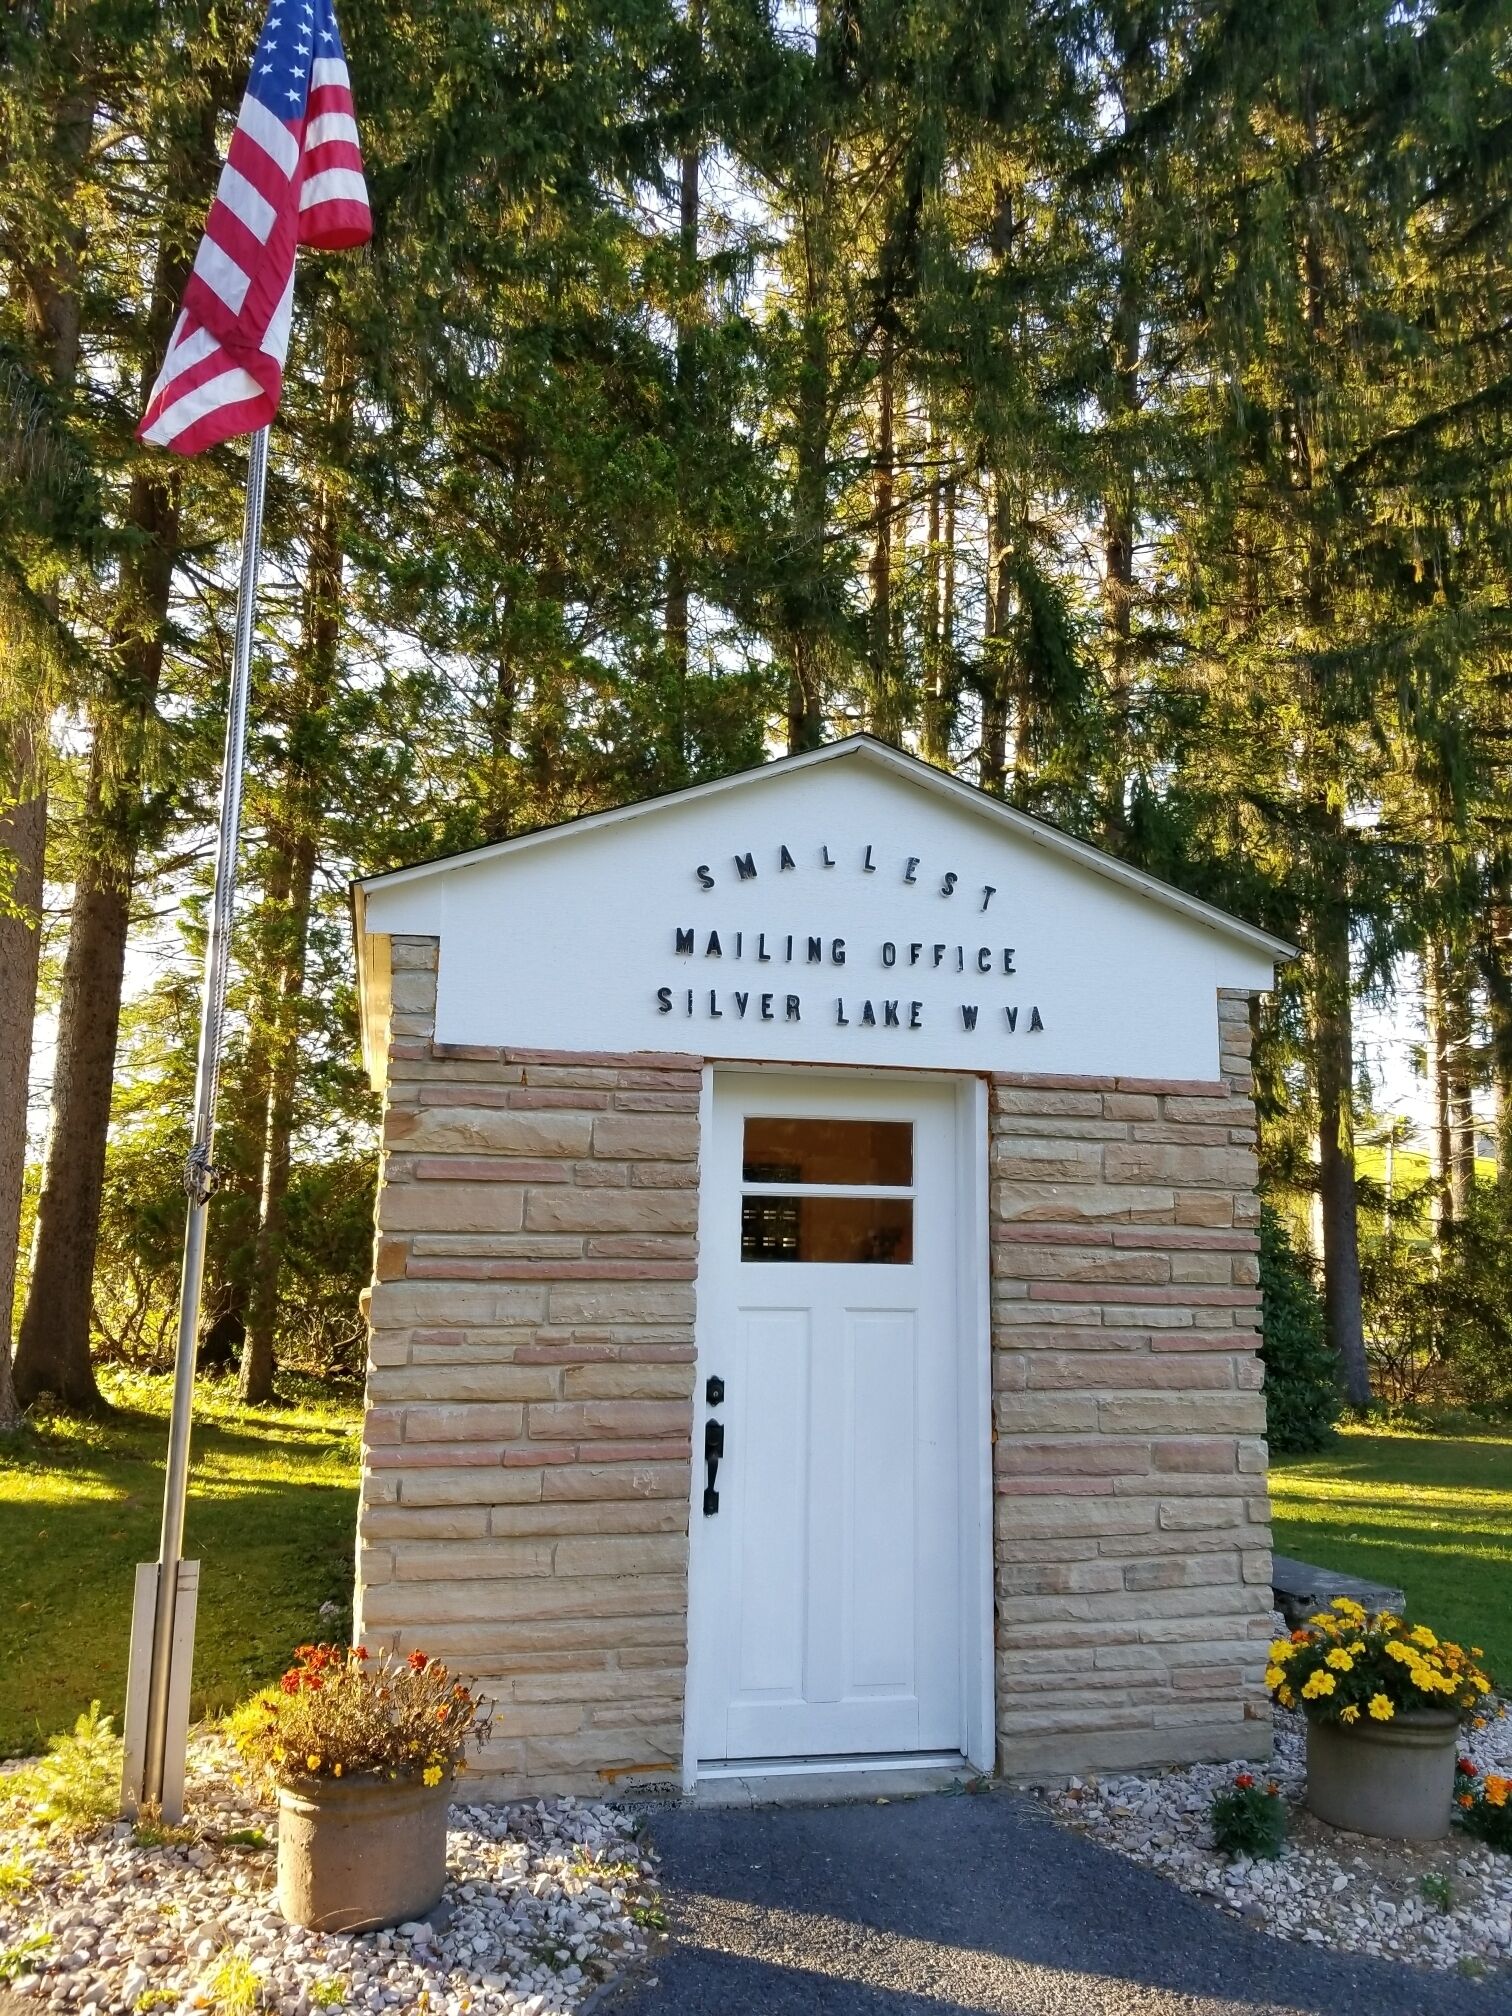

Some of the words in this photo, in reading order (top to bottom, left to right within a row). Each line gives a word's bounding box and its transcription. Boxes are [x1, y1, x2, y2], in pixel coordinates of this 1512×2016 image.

[696, 844, 997, 912] SMALLEST
[675, 927, 846, 966] MAILING
[881, 941, 1017, 974] OFFICE
[657, 987, 801, 1022] SILVER
[836, 997, 923, 1028] LAKE
[961, 1004, 979, 1031] W
[1005, 1006, 1044, 1033] VA
